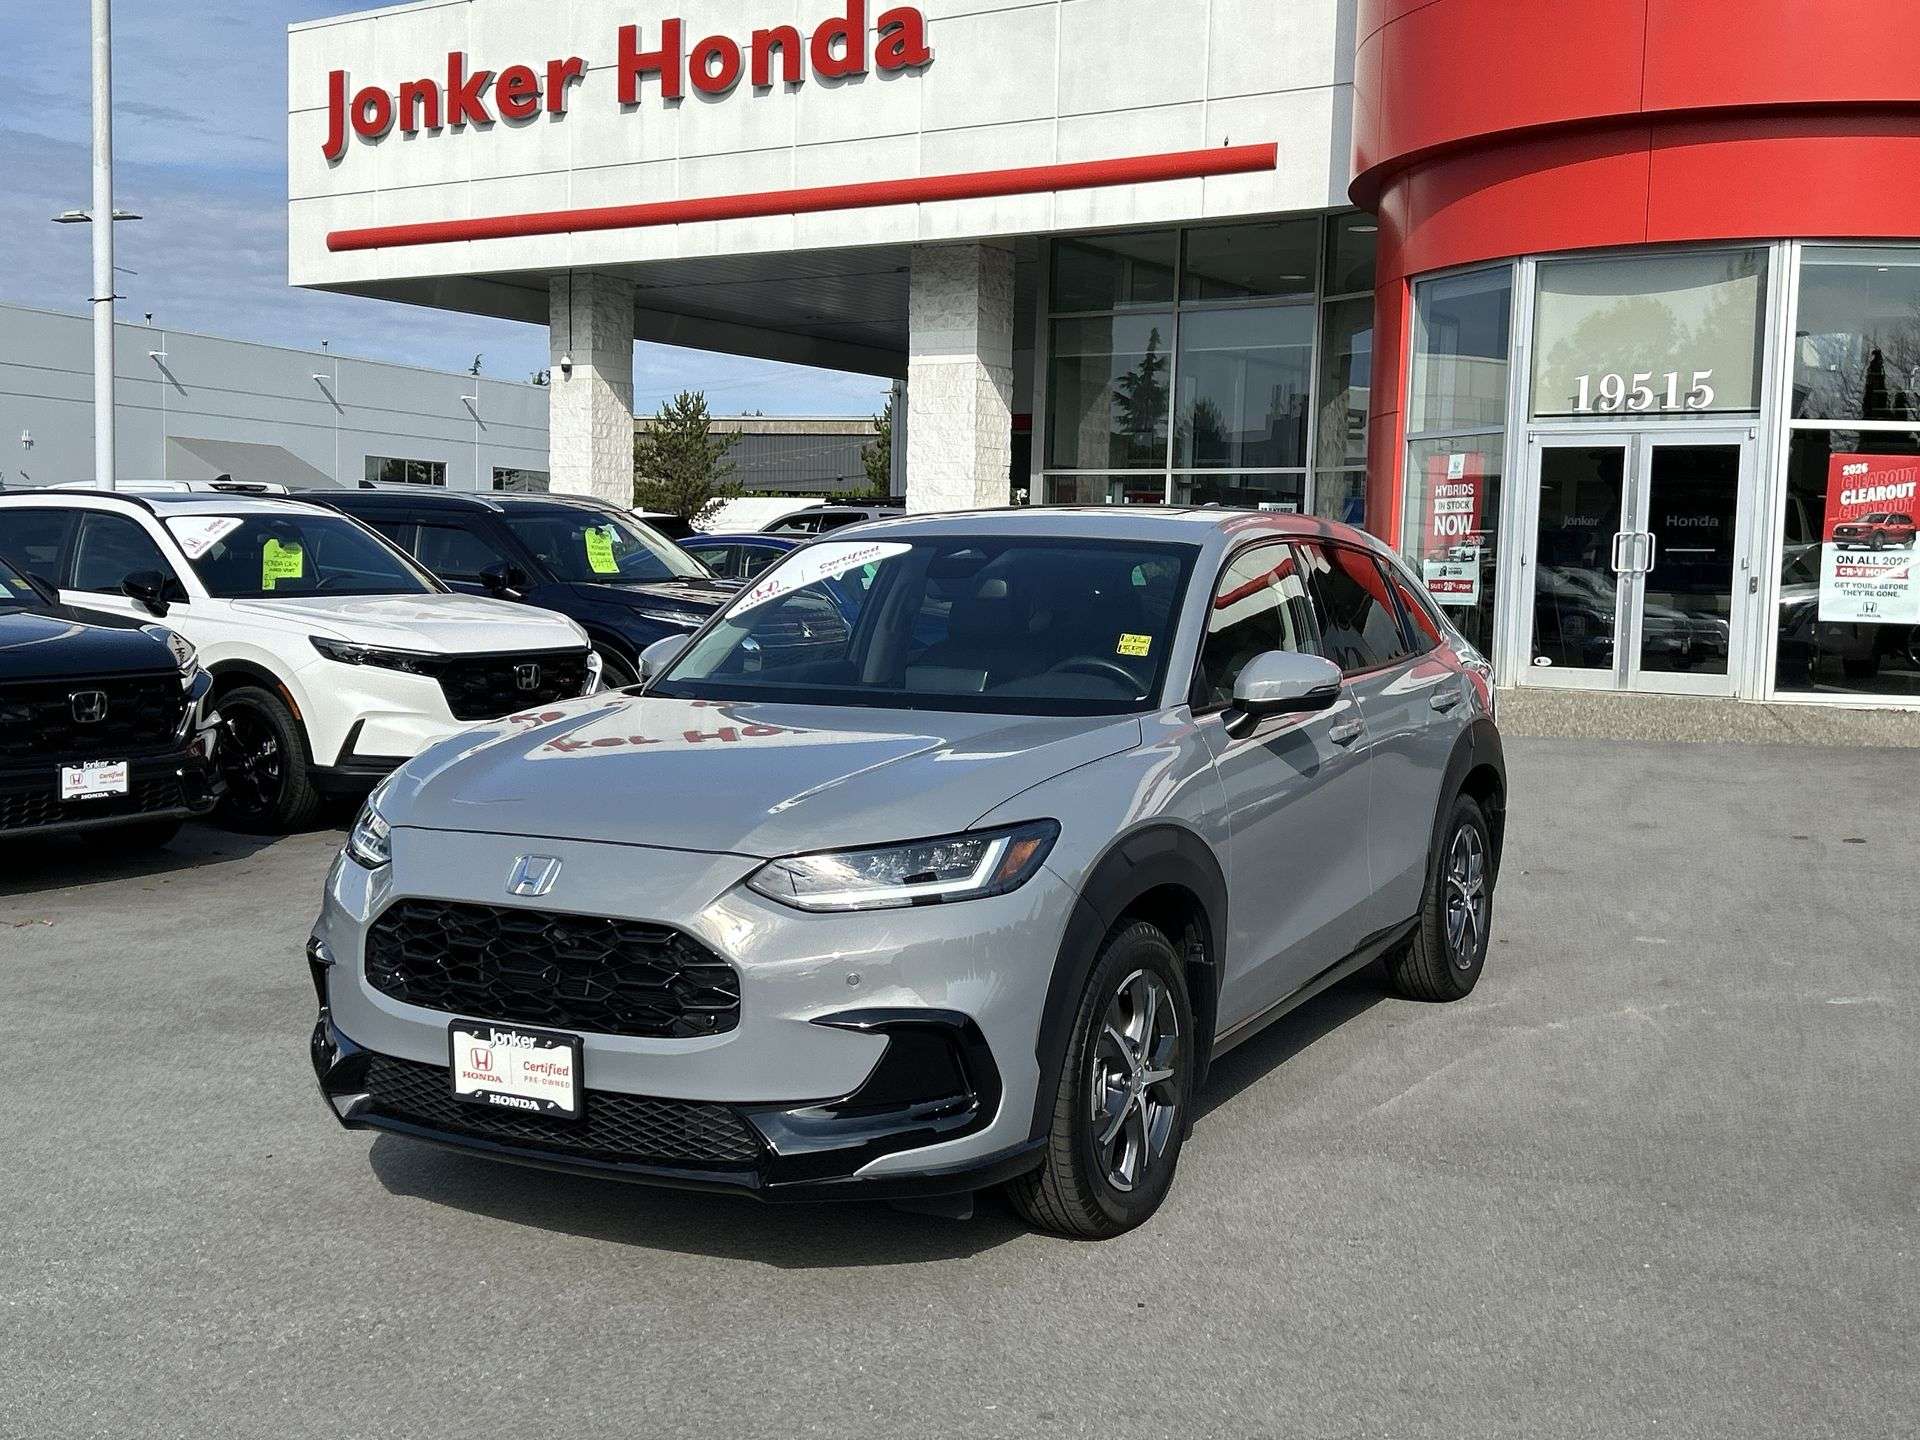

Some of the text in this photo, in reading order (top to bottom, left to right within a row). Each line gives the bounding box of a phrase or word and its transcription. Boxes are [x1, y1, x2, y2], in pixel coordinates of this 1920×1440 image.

[322, 0, 933, 160] Jonker Honda
[1573, 369, 1715, 411] 19515
[1842, 463, 1869, 476] 2026
[1435, 484, 1474, 496] HYBRIDS
[1840, 482, 1917, 505] CLEAROUT
[1446, 500, 1470, 510] STOCK
[1433, 514, 1474, 536] NOW
[1561, 514, 1719, 529] Jonker Honda
[1836, 555, 1854, 565] ON
[1857, 555, 1879, 565] ALL
[1834, 581, 1851, 589] GET
[1879, 583, 1909, 591] BEFORE
[80, 760, 109, 773] Jonker
[80, 792, 109, 800] HONDA
[489, 1027, 537, 1049] Jonker
[523, 1060, 569, 1077] Certified
[462, 1071, 503, 1084] HONDA
[489, 1094, 540, 1111] HONDA
